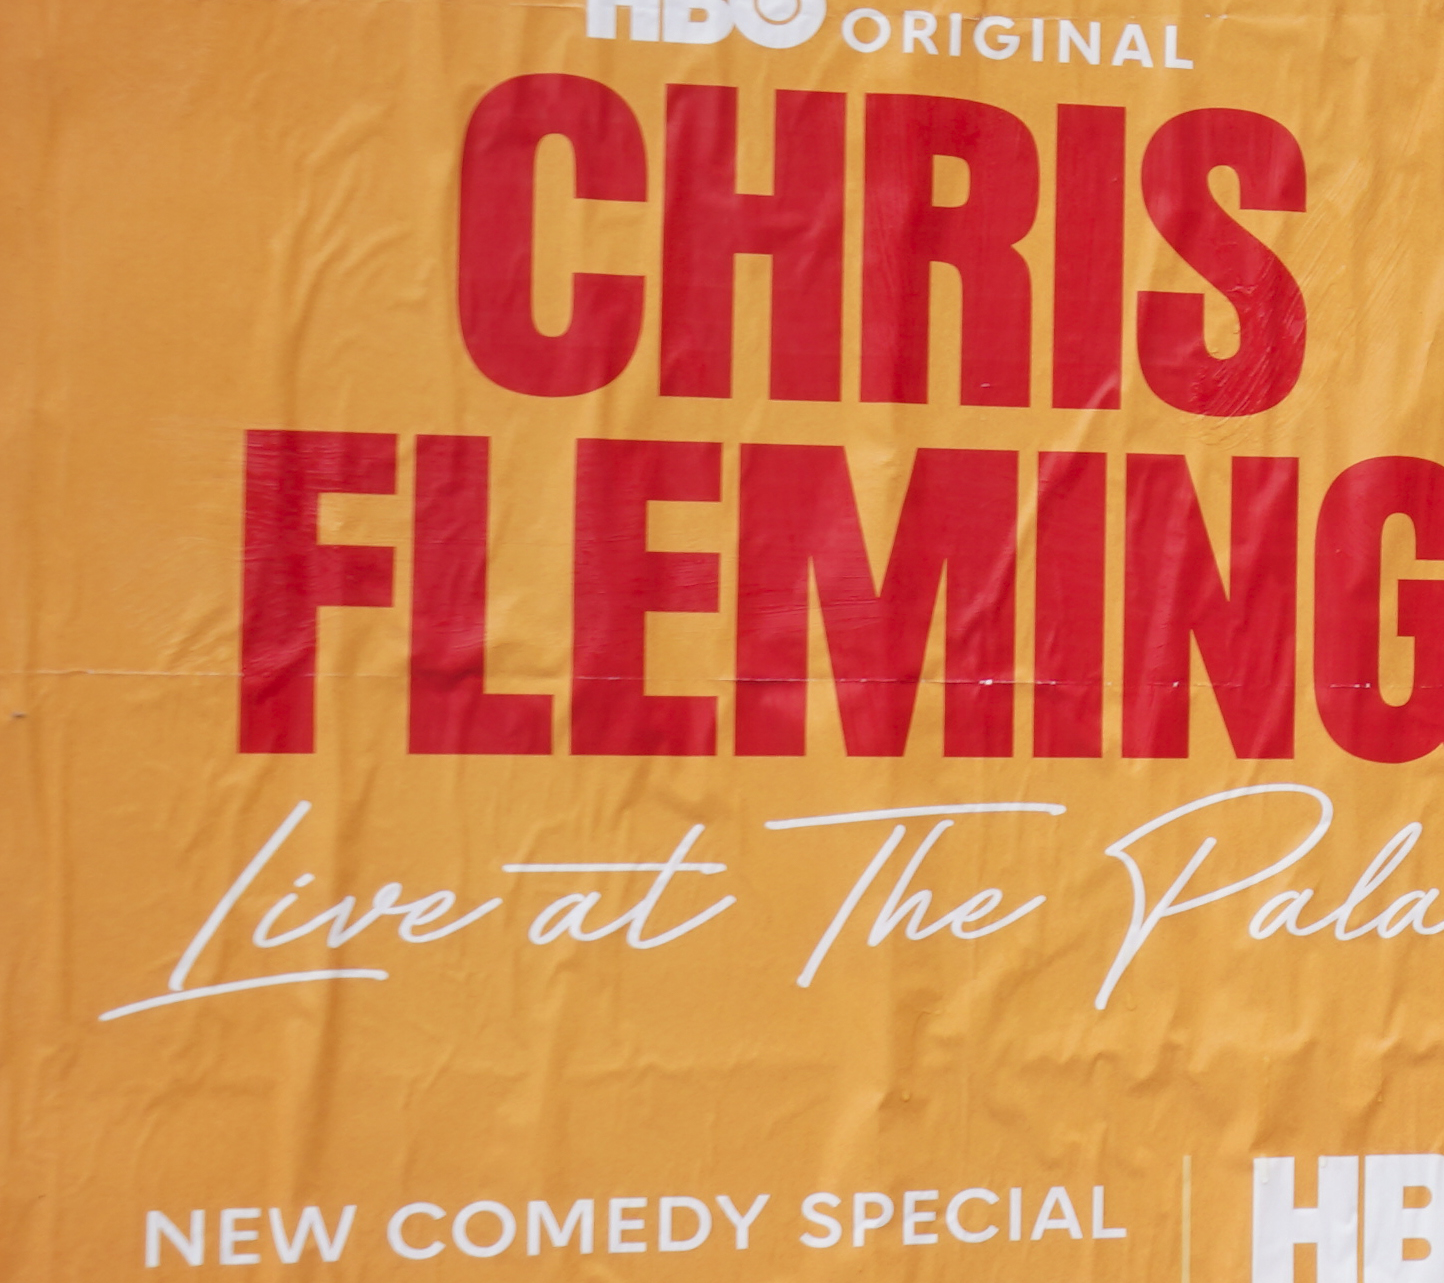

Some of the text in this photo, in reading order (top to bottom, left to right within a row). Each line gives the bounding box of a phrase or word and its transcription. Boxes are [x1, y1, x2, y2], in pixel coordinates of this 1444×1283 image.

[841, 8, 1195, 70] ORIGINAL
[457, 72, 1307, 418] CHRIS
[98, 799, 503, 1023] Live
[501, 823, 738, 950] at
[764, 801, 1067, 989] The
[144, 1184, 1127, 1269] NEW COMEDY SPECIAL
